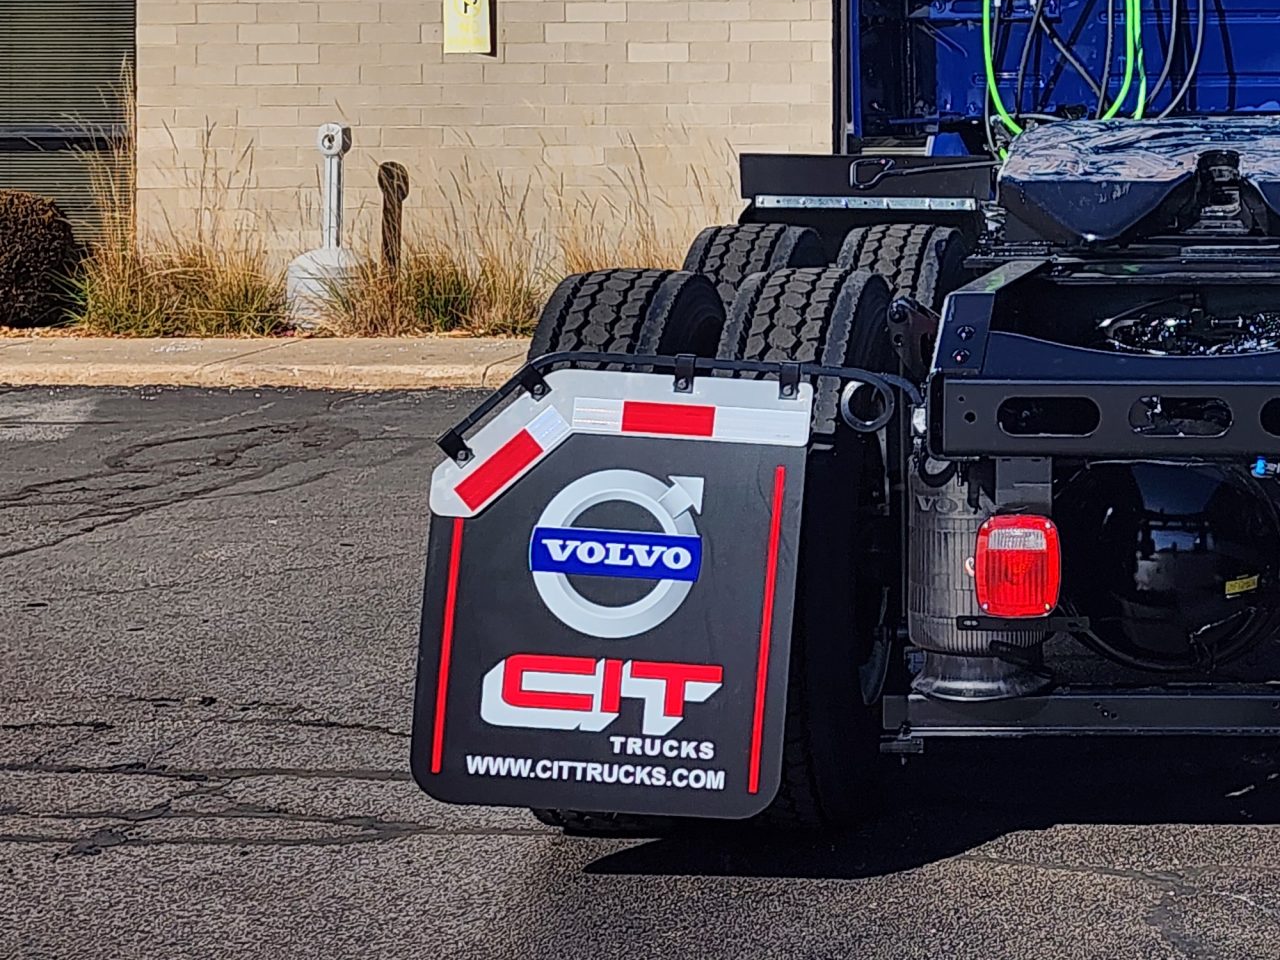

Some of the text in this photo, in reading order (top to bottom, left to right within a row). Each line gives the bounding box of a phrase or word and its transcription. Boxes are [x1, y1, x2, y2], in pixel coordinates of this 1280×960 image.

[541, 538, 692, 570] VOLVO
[482, 653, 724, 734] CIT
[609, 735, 715, 759] TRUCKS
[466, 755, 725, 791] WWW.CITTRUCKS.COM
